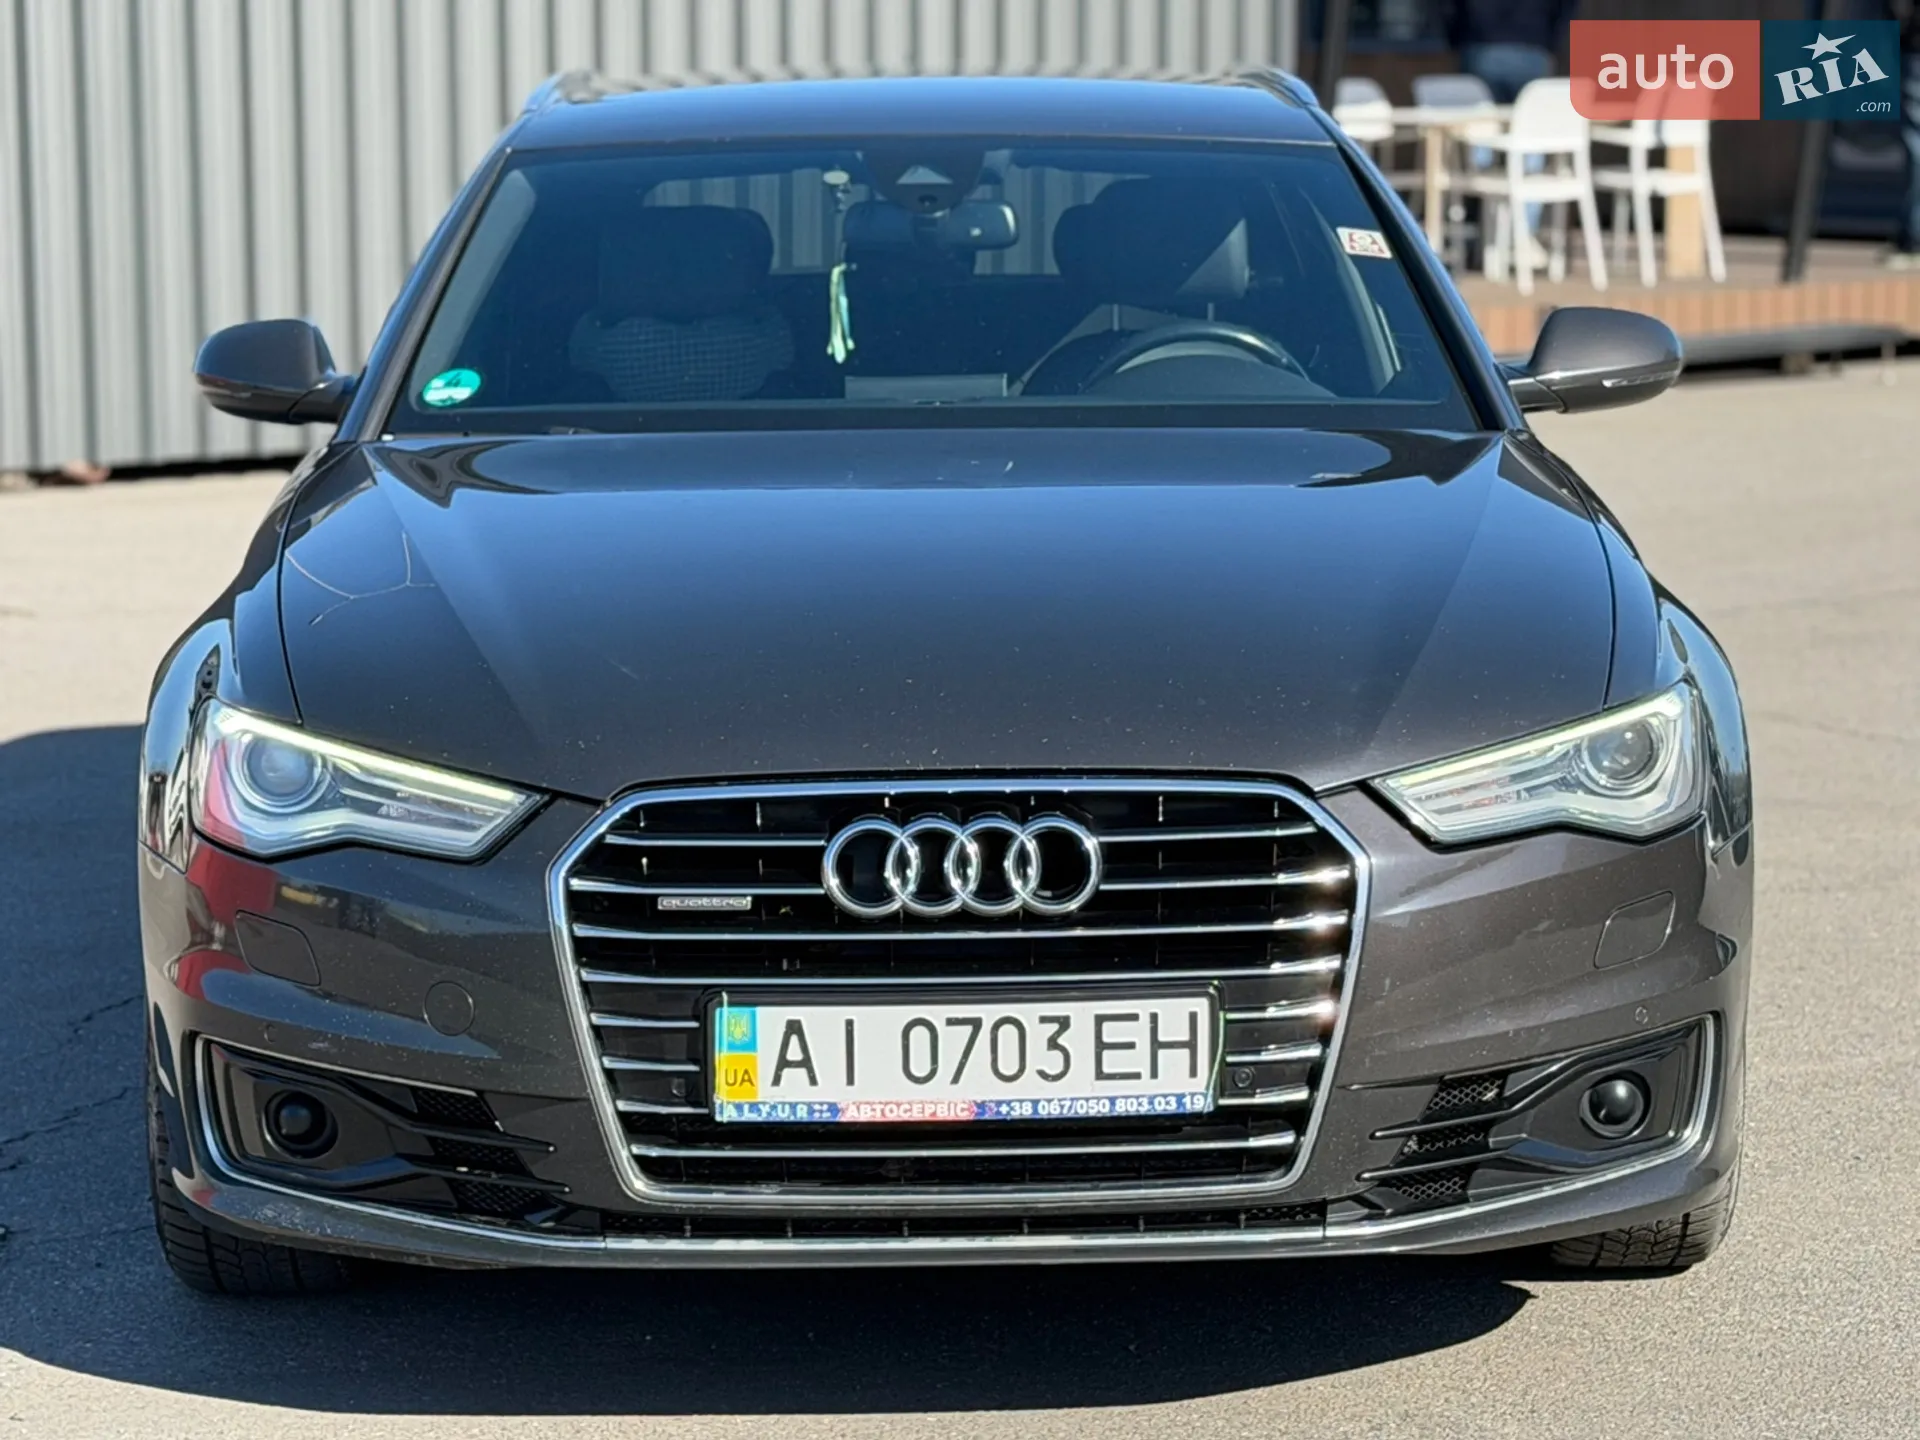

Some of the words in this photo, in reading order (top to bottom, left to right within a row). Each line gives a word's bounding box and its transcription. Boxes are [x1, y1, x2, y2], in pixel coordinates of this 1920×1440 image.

[661, 897, 748, 909] quattro
[771, 1018, 855, 1087] AI
[901, 1015, 1071, 1086] 0703
[1094, 1011, 1198, 1081] EH
[725, 1068, 755, 1087] UA
[999, 1100, 1033, 1116] +38
[1037, 1098, 1110, 1116] 067/050
[1115, 1097, 1149, 1113] 803
[1153, 1095, 1177, 1112] 03
[1181, 1093, 1205, 1110] 19
